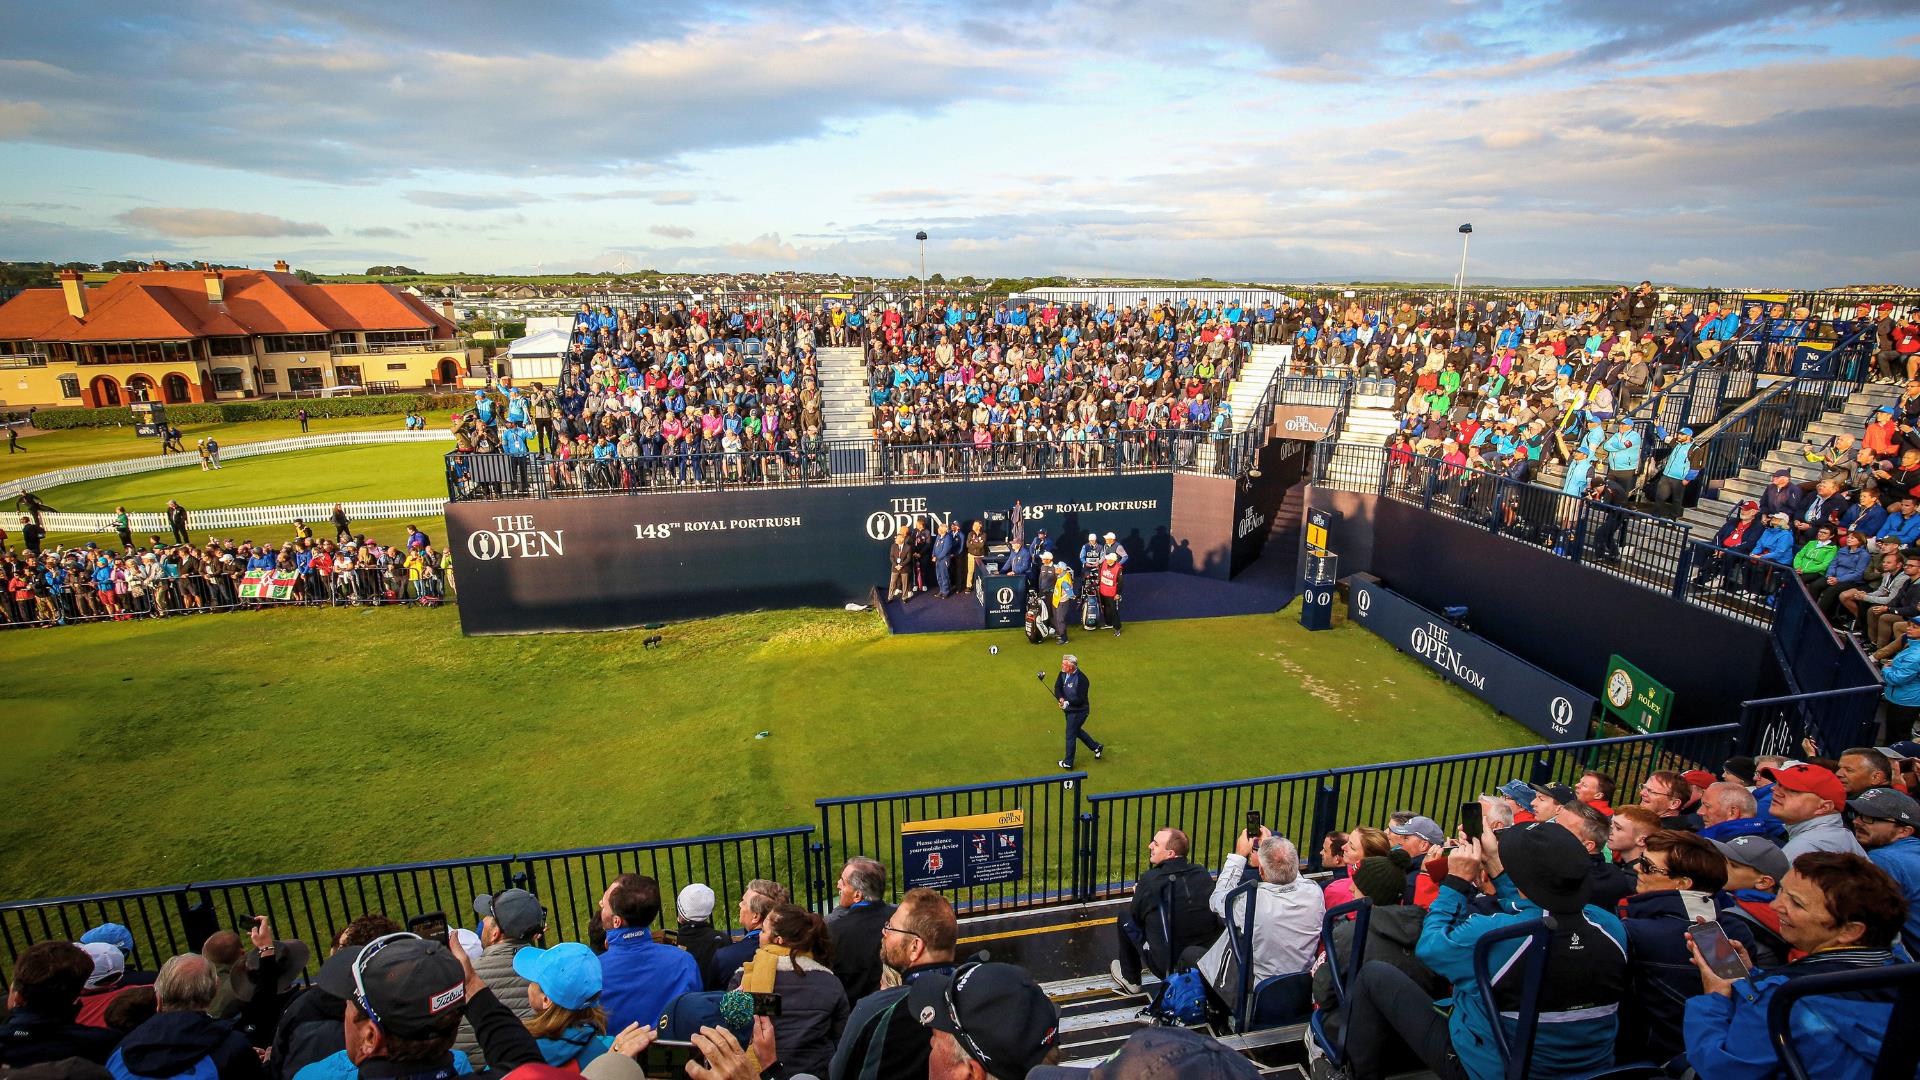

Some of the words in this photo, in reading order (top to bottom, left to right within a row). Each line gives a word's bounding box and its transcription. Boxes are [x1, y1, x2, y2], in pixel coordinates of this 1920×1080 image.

[1806, 352, 1819, 360] No
[1295, 415, 1309, 423] THE
[890, 497, 928, 513] THE
[1022, 504, 1054, 519] 48TH
[1056, 502, 1093, 513] ROYAL
[1096, 499, 1158, 511] PORTRUSH
[492, 515, 535, 531] THE
[633, 522, 681, 539] 148TH
[684, 520, 727, 532] ROYAL
[730, 516, 801, 529] PORTRUSH
[467, 529, 564, 560] OPEN
[1428, 621, 1449, 645] THE
[1638, 693, 1661, 715] ROLEX
[998, 815, 1021, 824] OPEN
